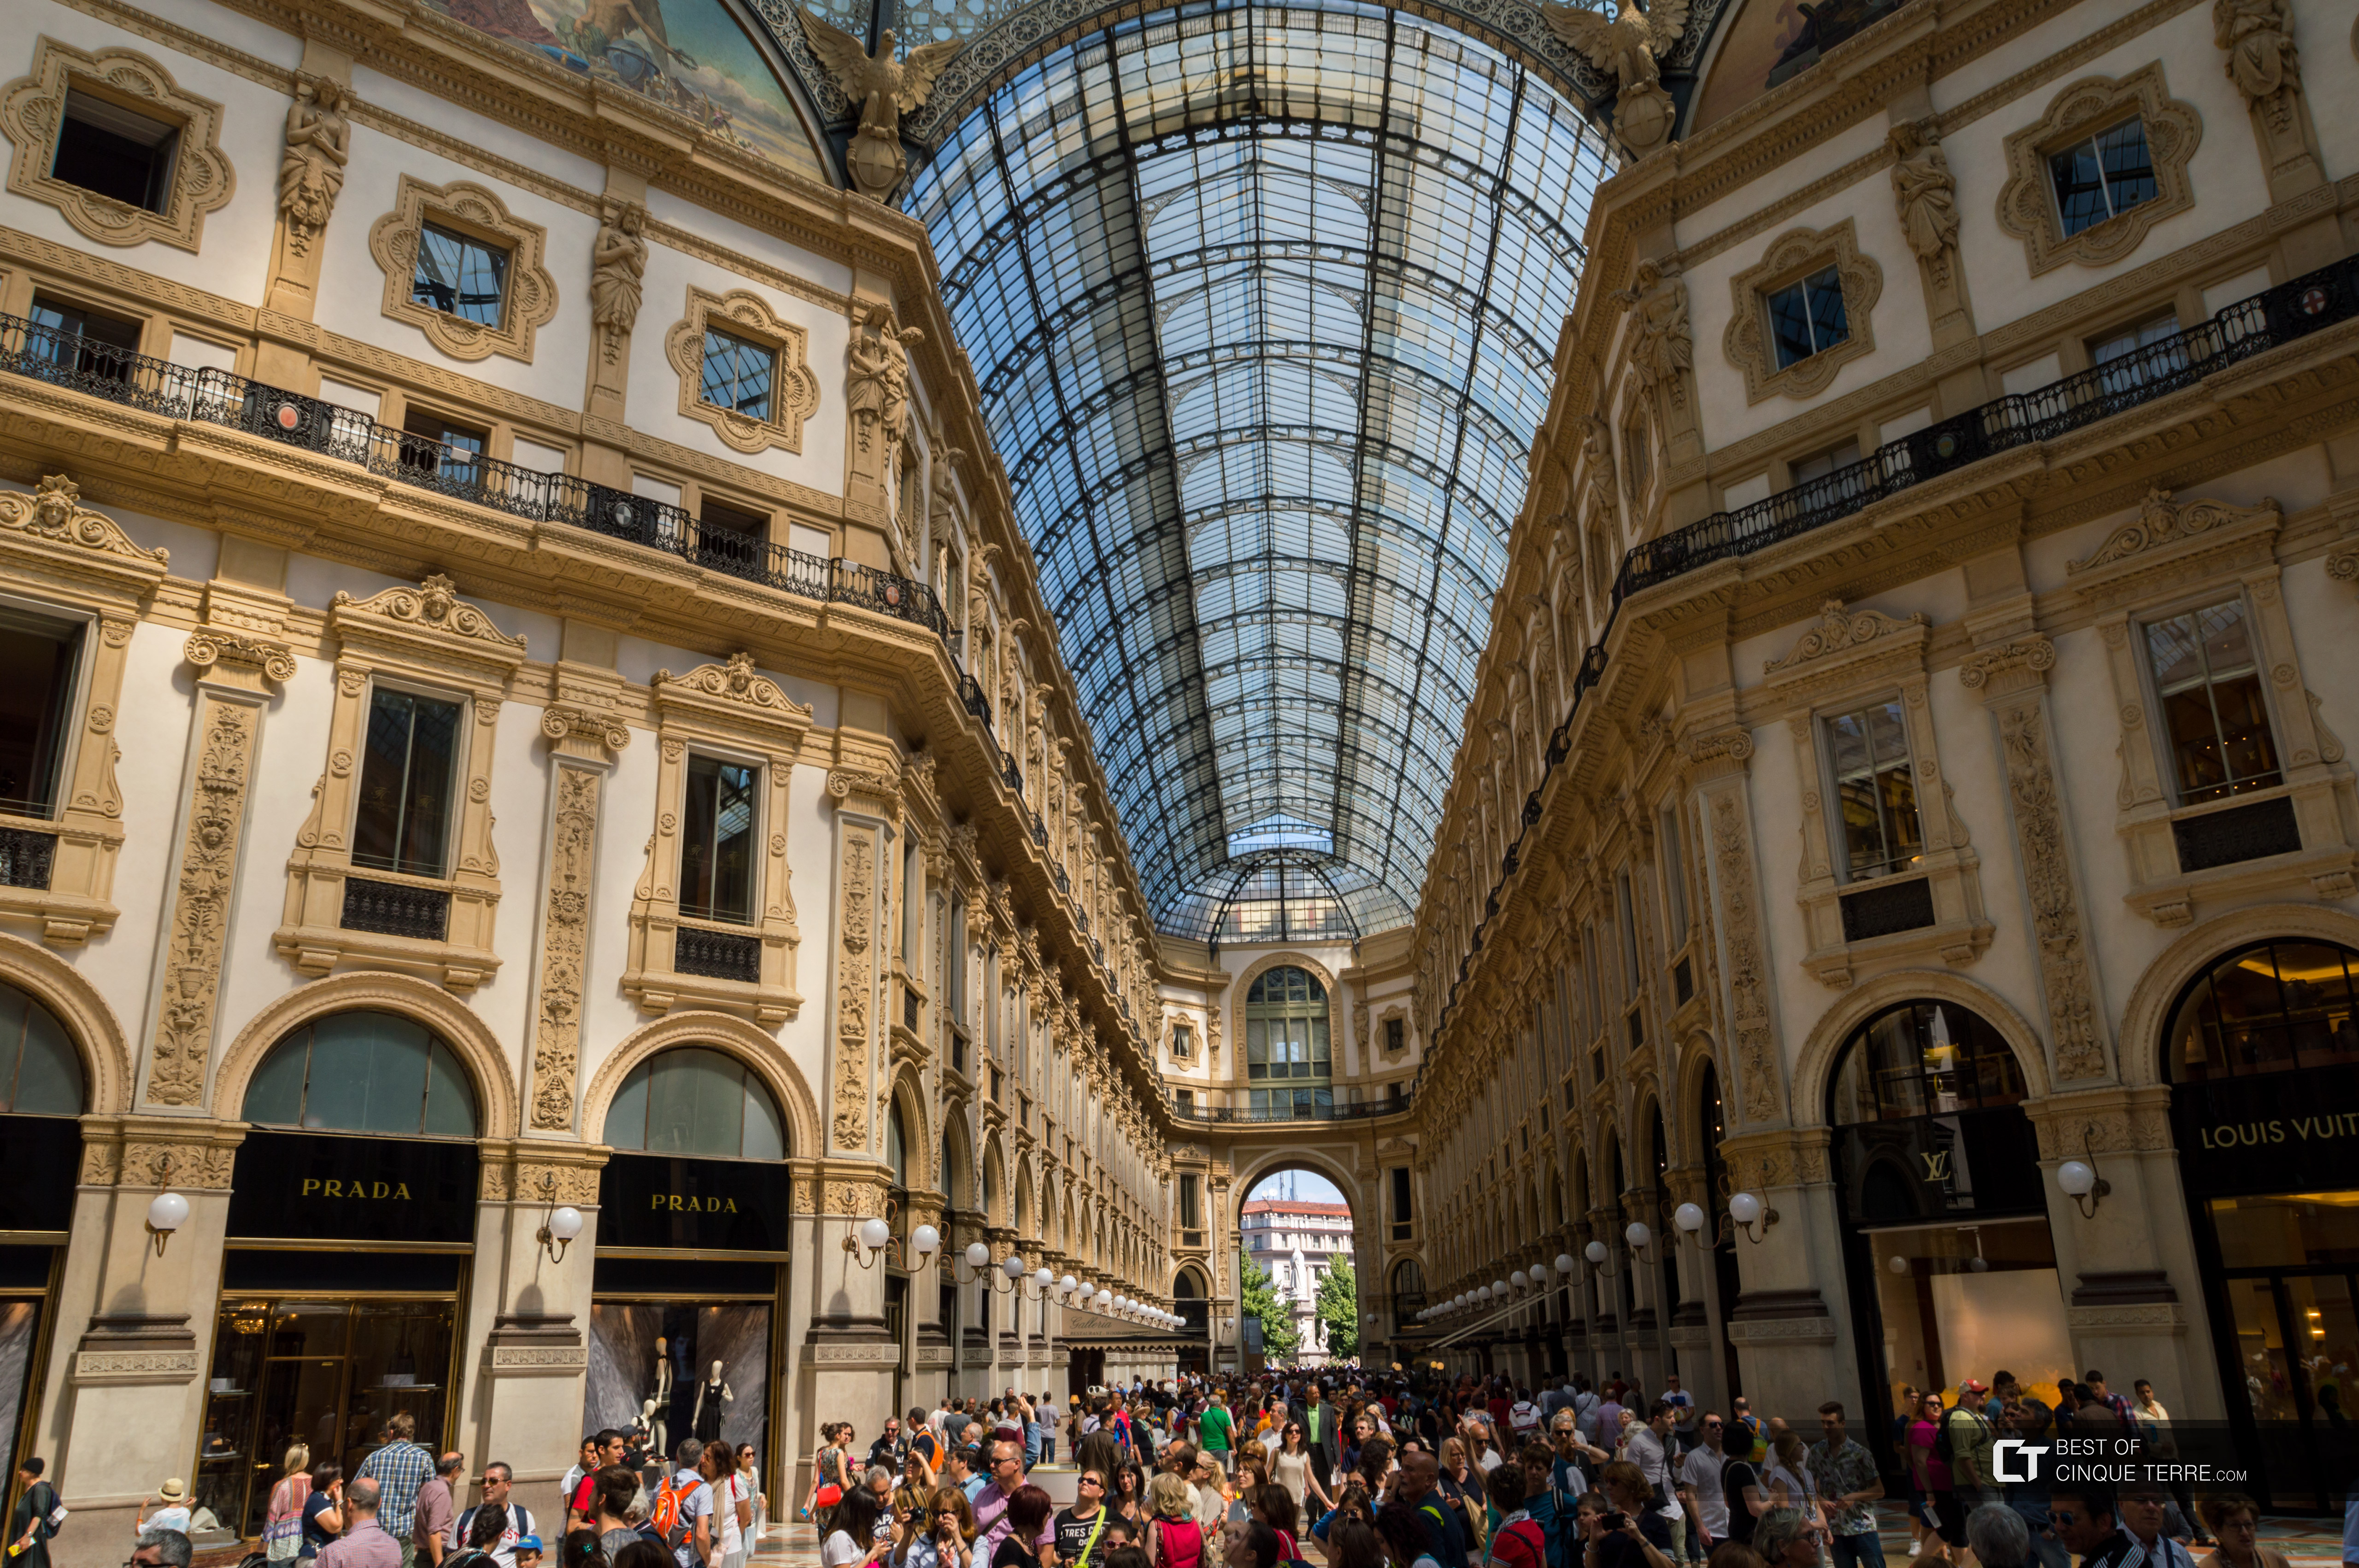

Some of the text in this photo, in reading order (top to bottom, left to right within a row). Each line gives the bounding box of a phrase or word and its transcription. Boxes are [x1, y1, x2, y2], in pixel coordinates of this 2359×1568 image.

[2201, 1112, 2359, 1149] LOUIS VUIT
[302, 1179, 412, 1200] PRADA
[651, 1194, 738, 1213] PRADA
[1070, 1316, 1112, 1329] Galleria
[1065, 1527, 1086, 1537] TRES
